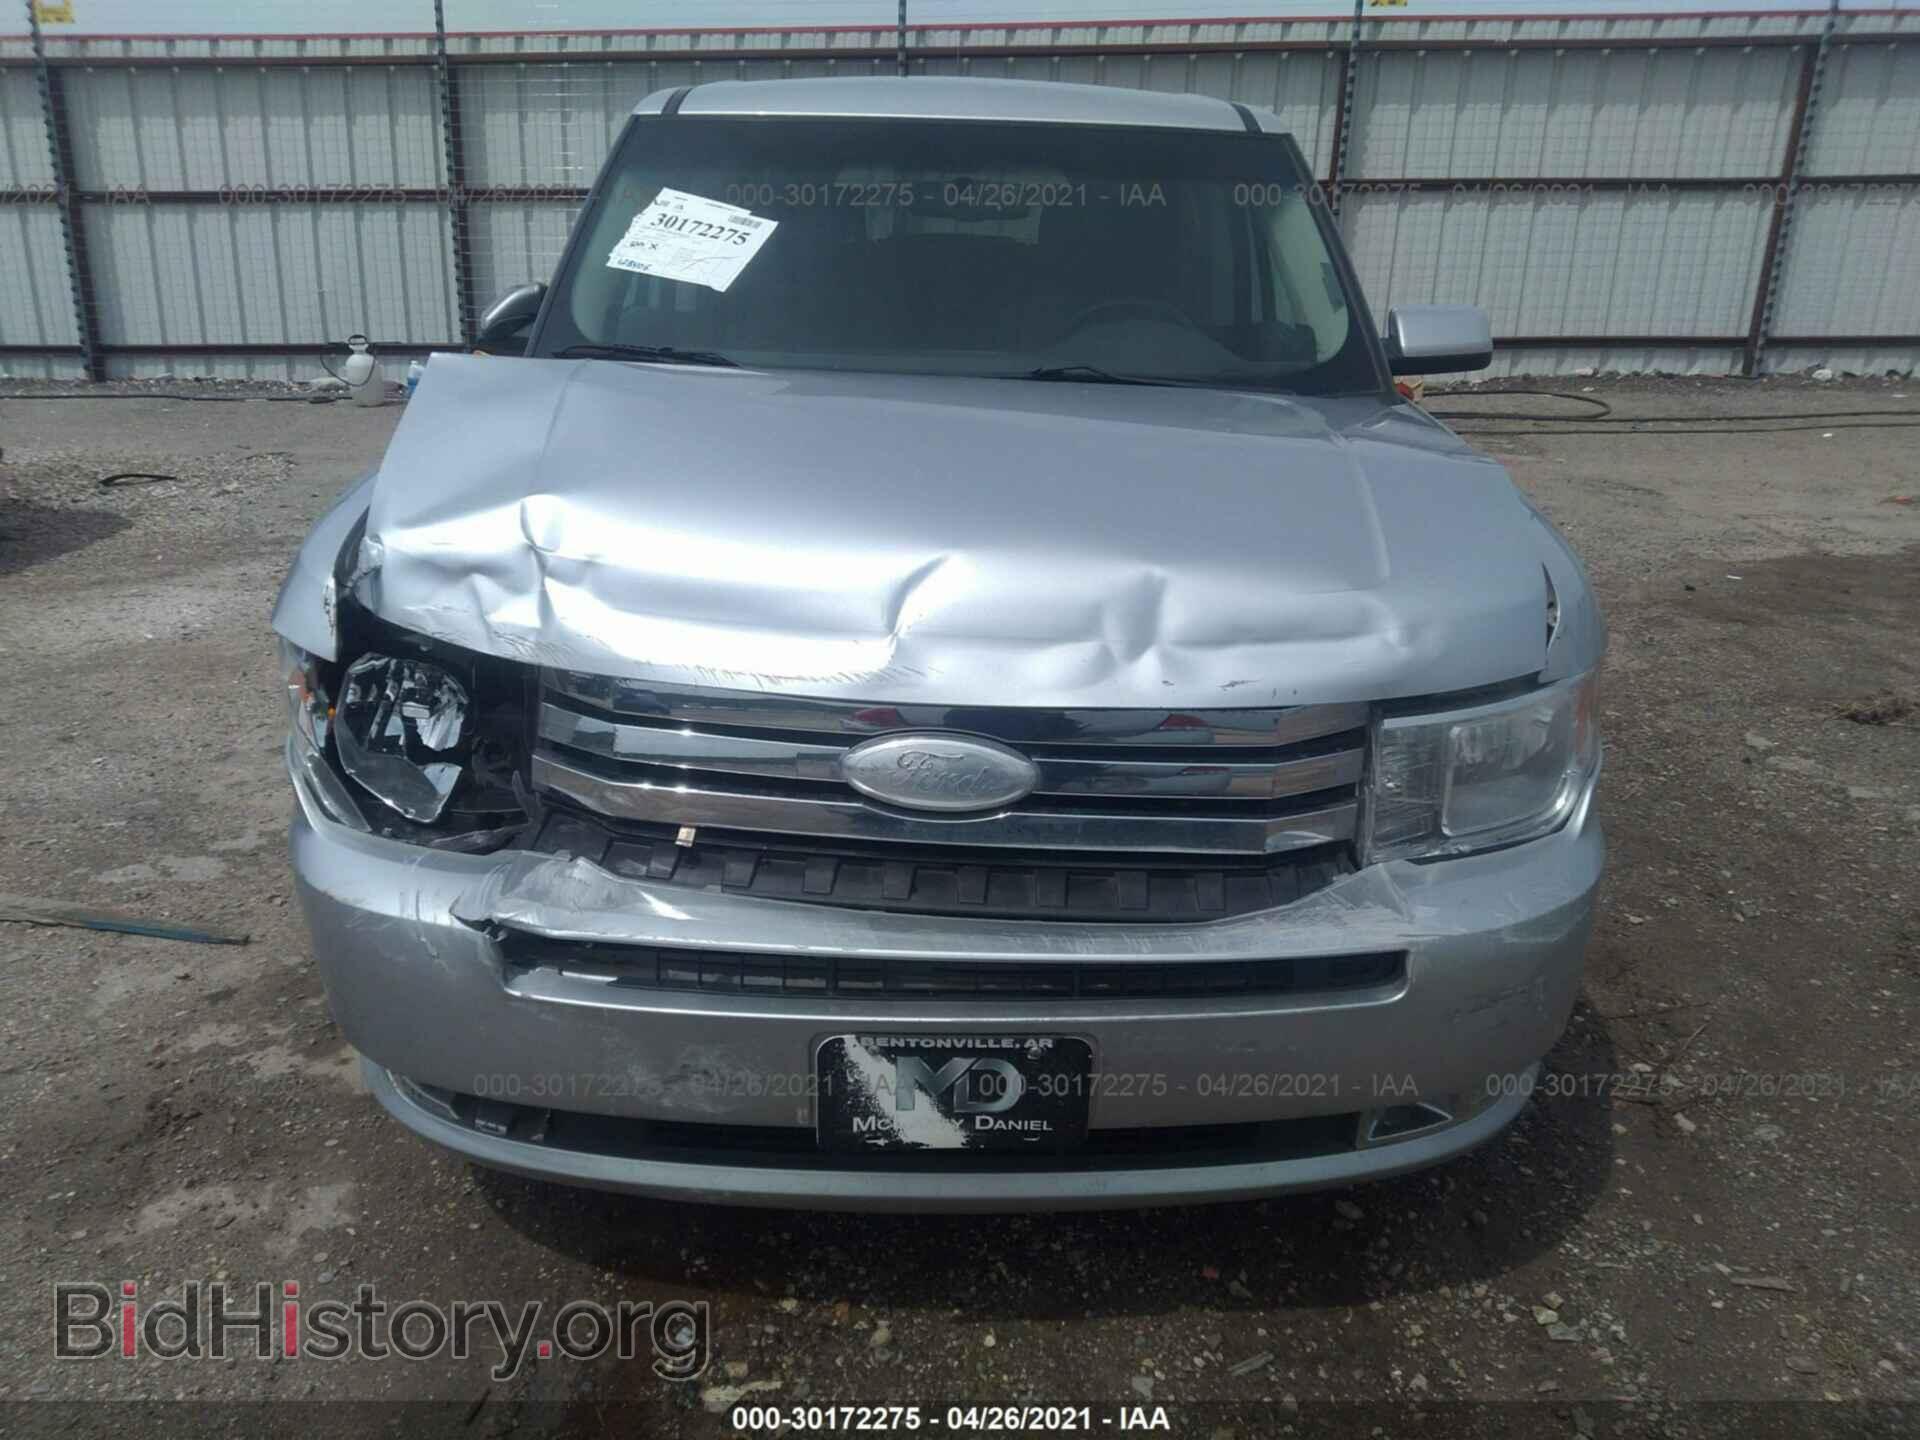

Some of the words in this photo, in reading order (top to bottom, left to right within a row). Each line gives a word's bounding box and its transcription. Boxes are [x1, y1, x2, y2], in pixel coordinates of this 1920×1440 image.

[651, 212, 752, 246] 30172275
[894, 749, 993, 800] Ford
[1024, 1038, 1054, 1050] AR
[895, 1056, 1021, 1112] MD
[974, 1115, 1053, 1132] DANIEL
